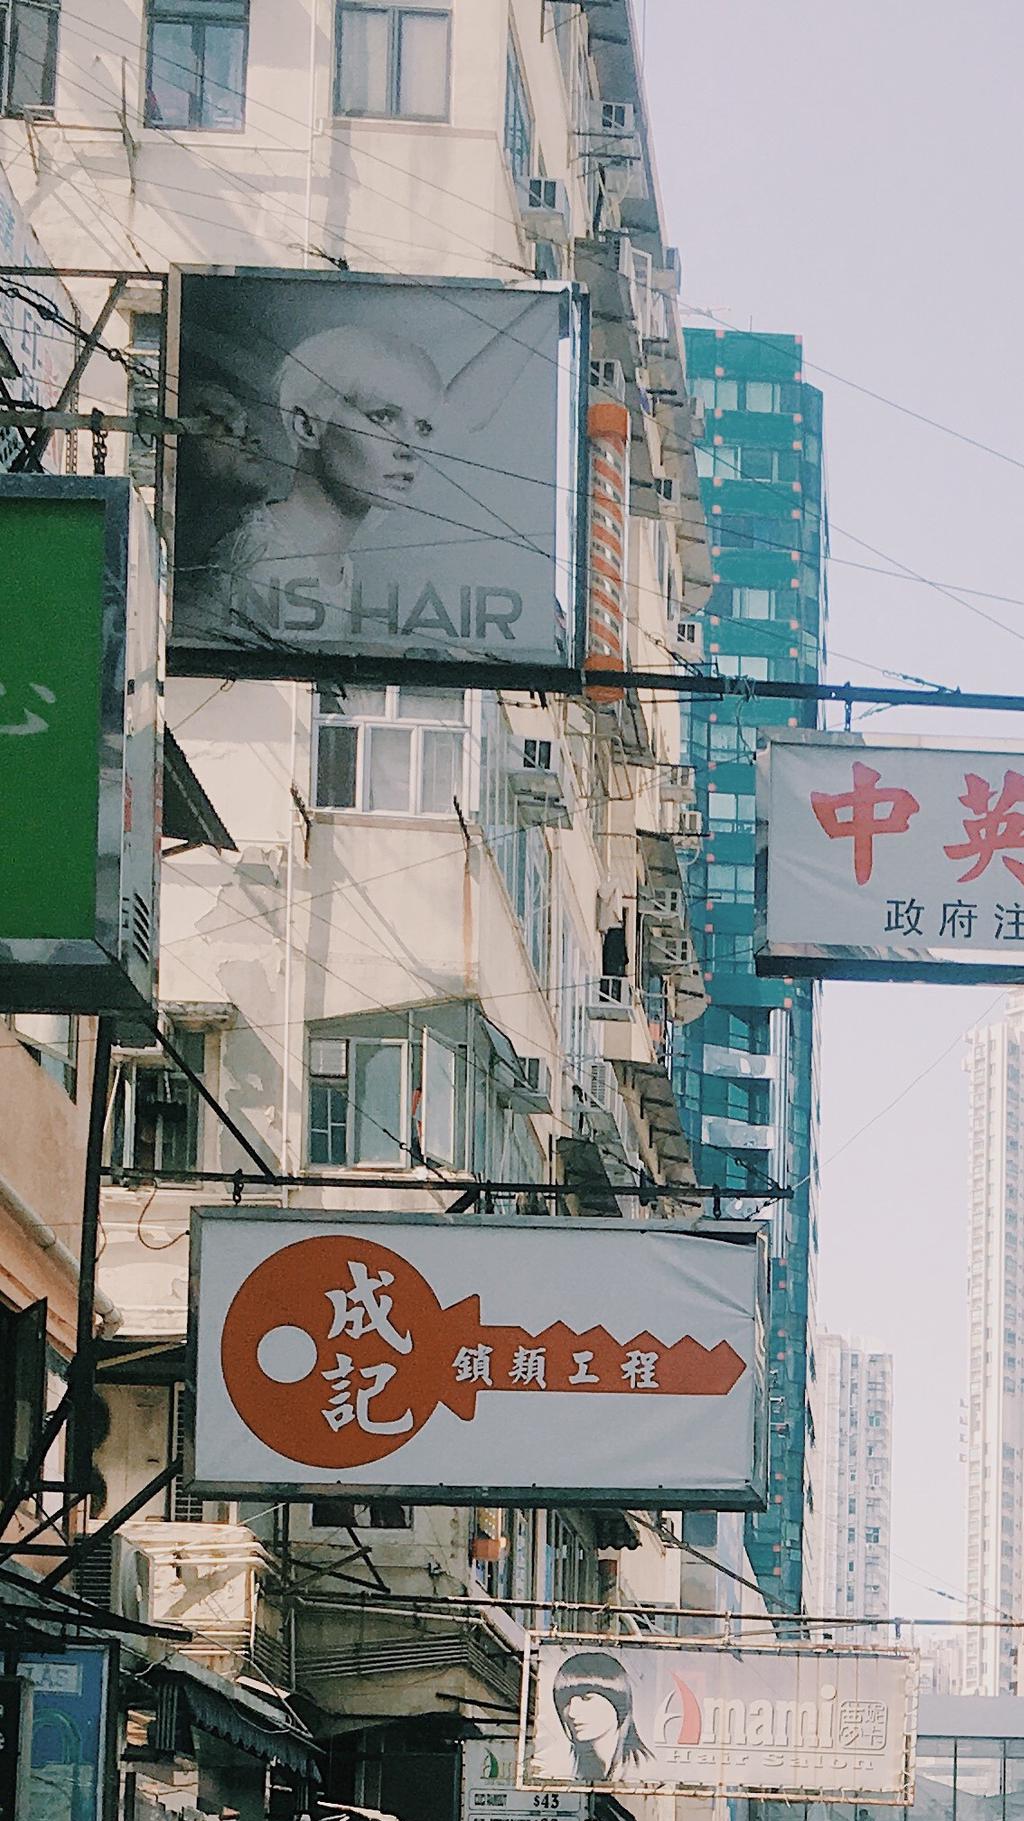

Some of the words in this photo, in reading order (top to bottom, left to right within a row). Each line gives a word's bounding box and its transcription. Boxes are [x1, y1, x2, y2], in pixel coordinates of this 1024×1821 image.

[351, 580, 523, 640] HAIR
[321, 1260, 414, 1436] 成記
[451, 1344, 660, 1391] 鎖類工程
[655, 1669, 838, 1748] Amami
[667, 1750, 750, 1766] Hair
[763, 1753, 875, 1771] Salon
[533, 1793, 560, 1809] $43
